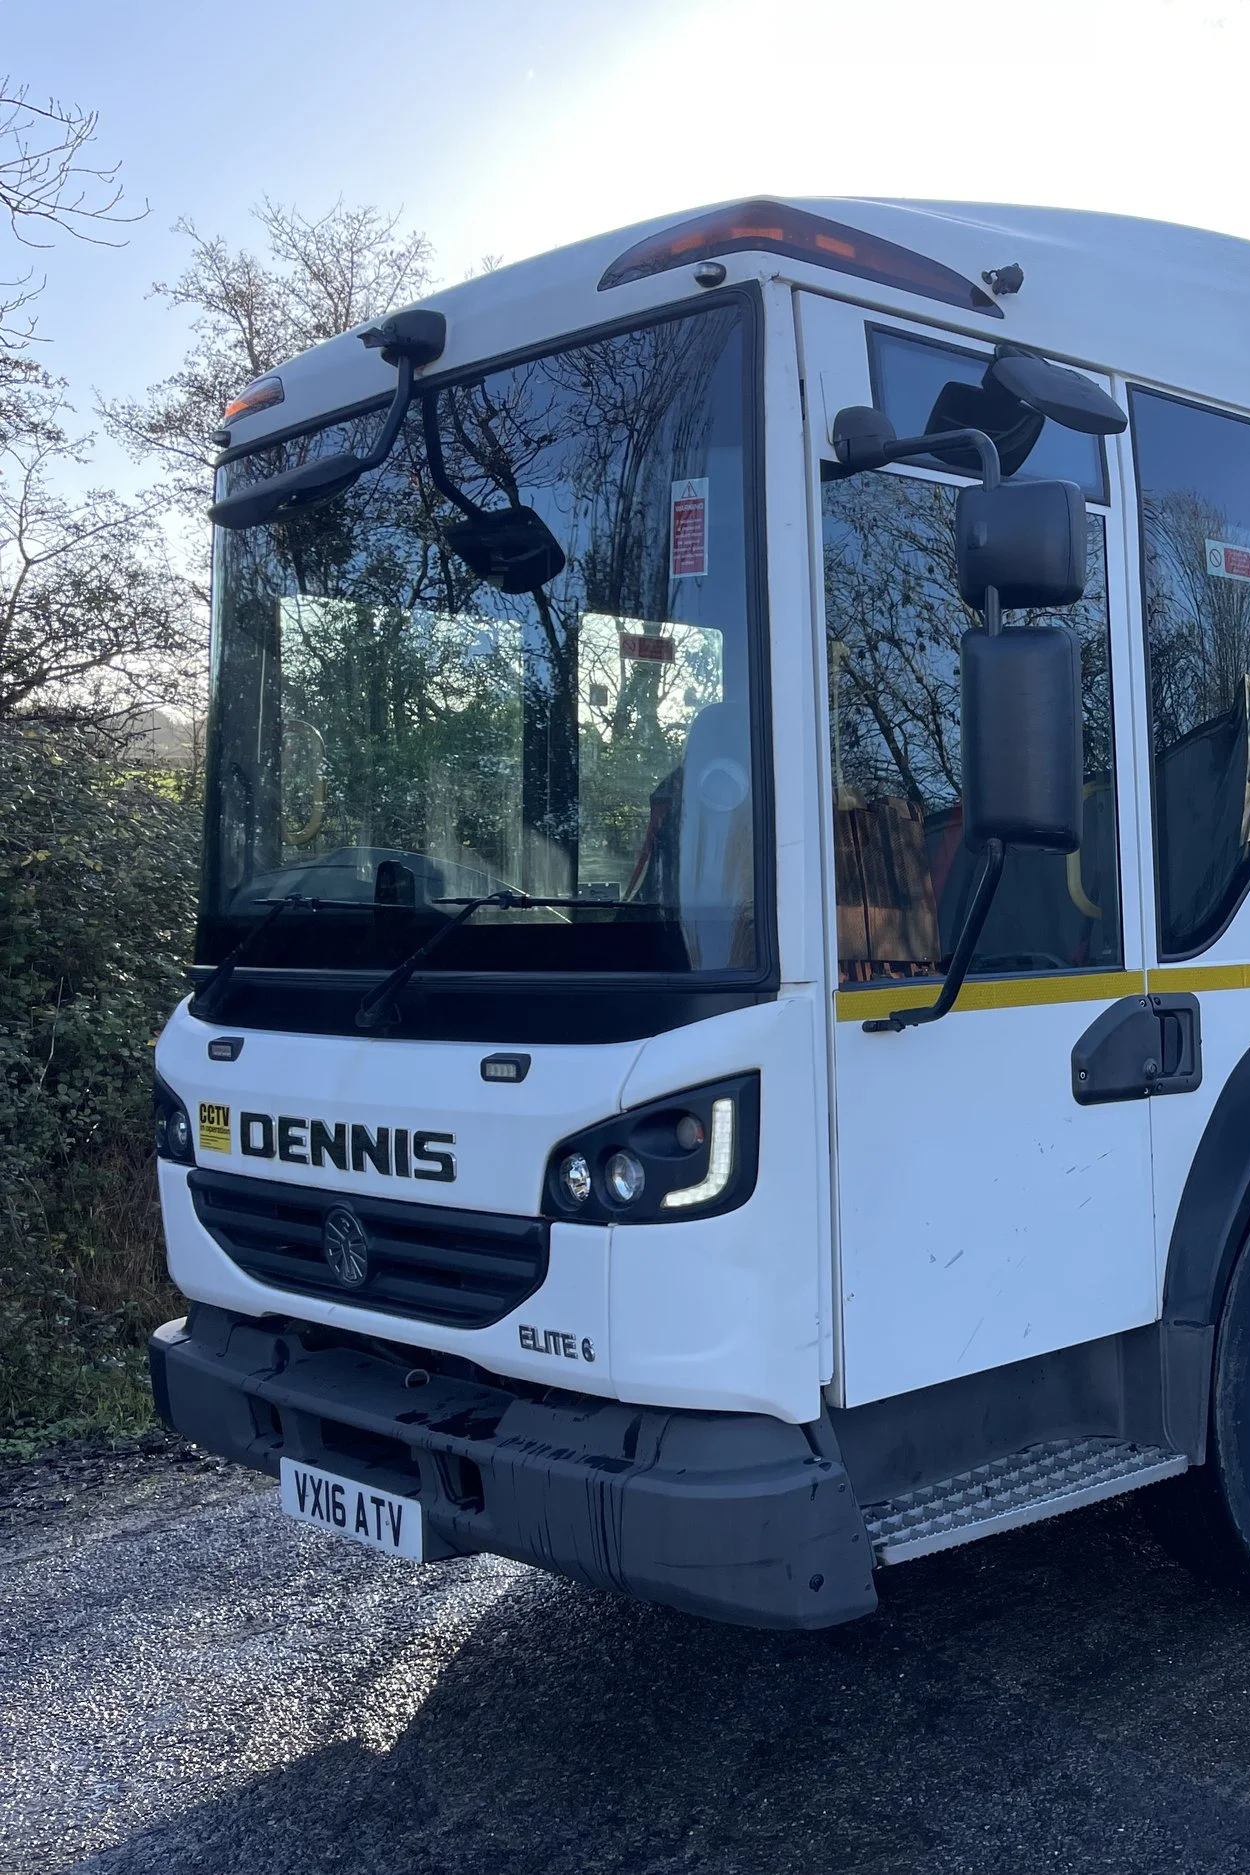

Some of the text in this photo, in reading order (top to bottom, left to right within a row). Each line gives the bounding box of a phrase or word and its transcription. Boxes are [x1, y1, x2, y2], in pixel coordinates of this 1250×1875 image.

[200, 1103, 230, 1127] CCTV
[240, 1111, 457, 1183] DENNIS
[518, 1324, 596, 1363] ELITE 6
[294, 1470, 403, 1547] VX16 ATV
